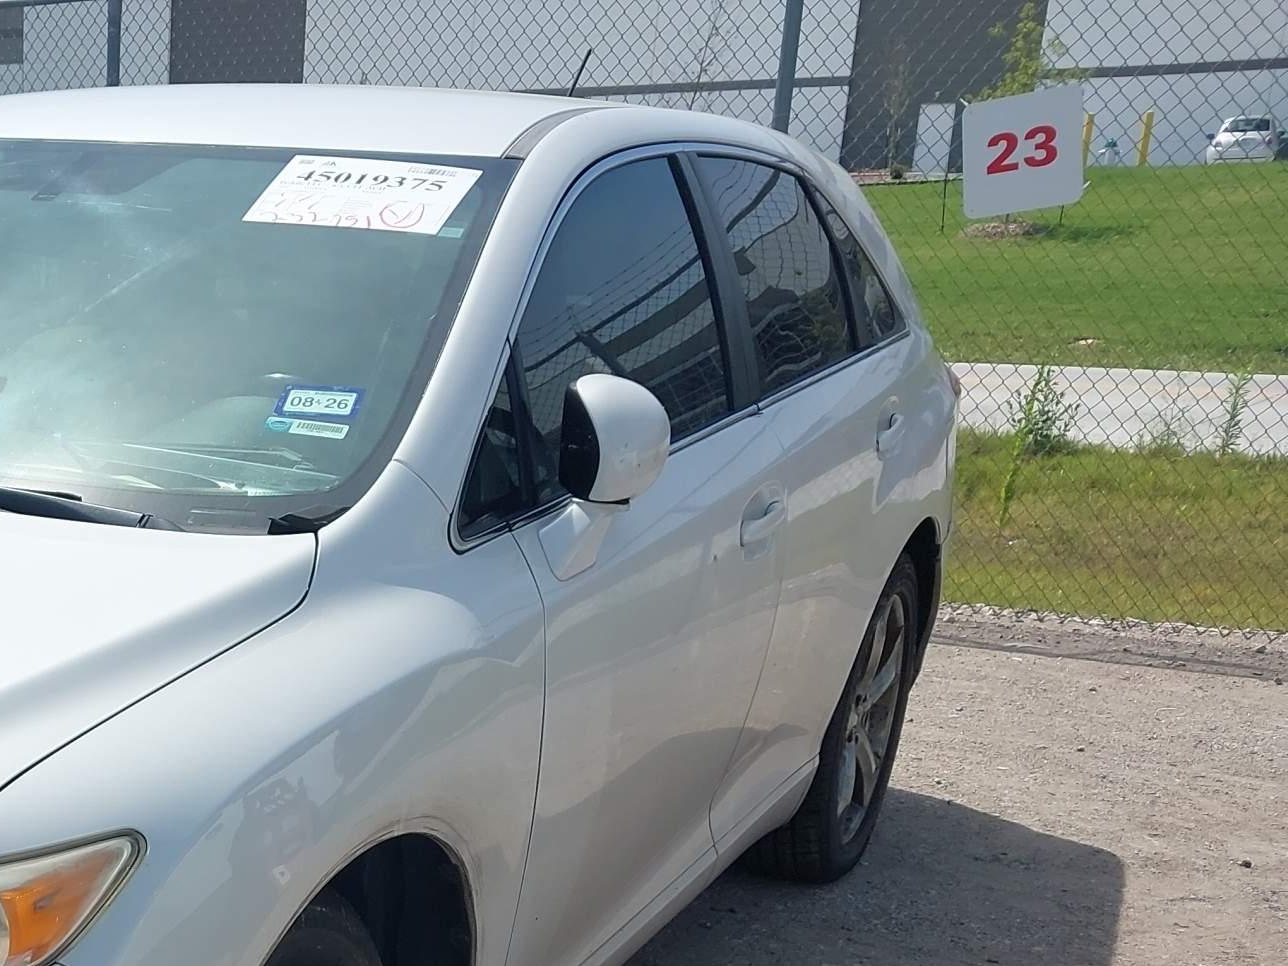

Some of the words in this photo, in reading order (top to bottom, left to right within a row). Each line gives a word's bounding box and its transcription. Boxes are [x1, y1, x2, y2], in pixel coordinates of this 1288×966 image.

[986, 124, 1058, 175] 23
[295, 169, 449, 192] 45019375
[290, 396, 315, 408] 08
[324, 398, 350, 410] 26
